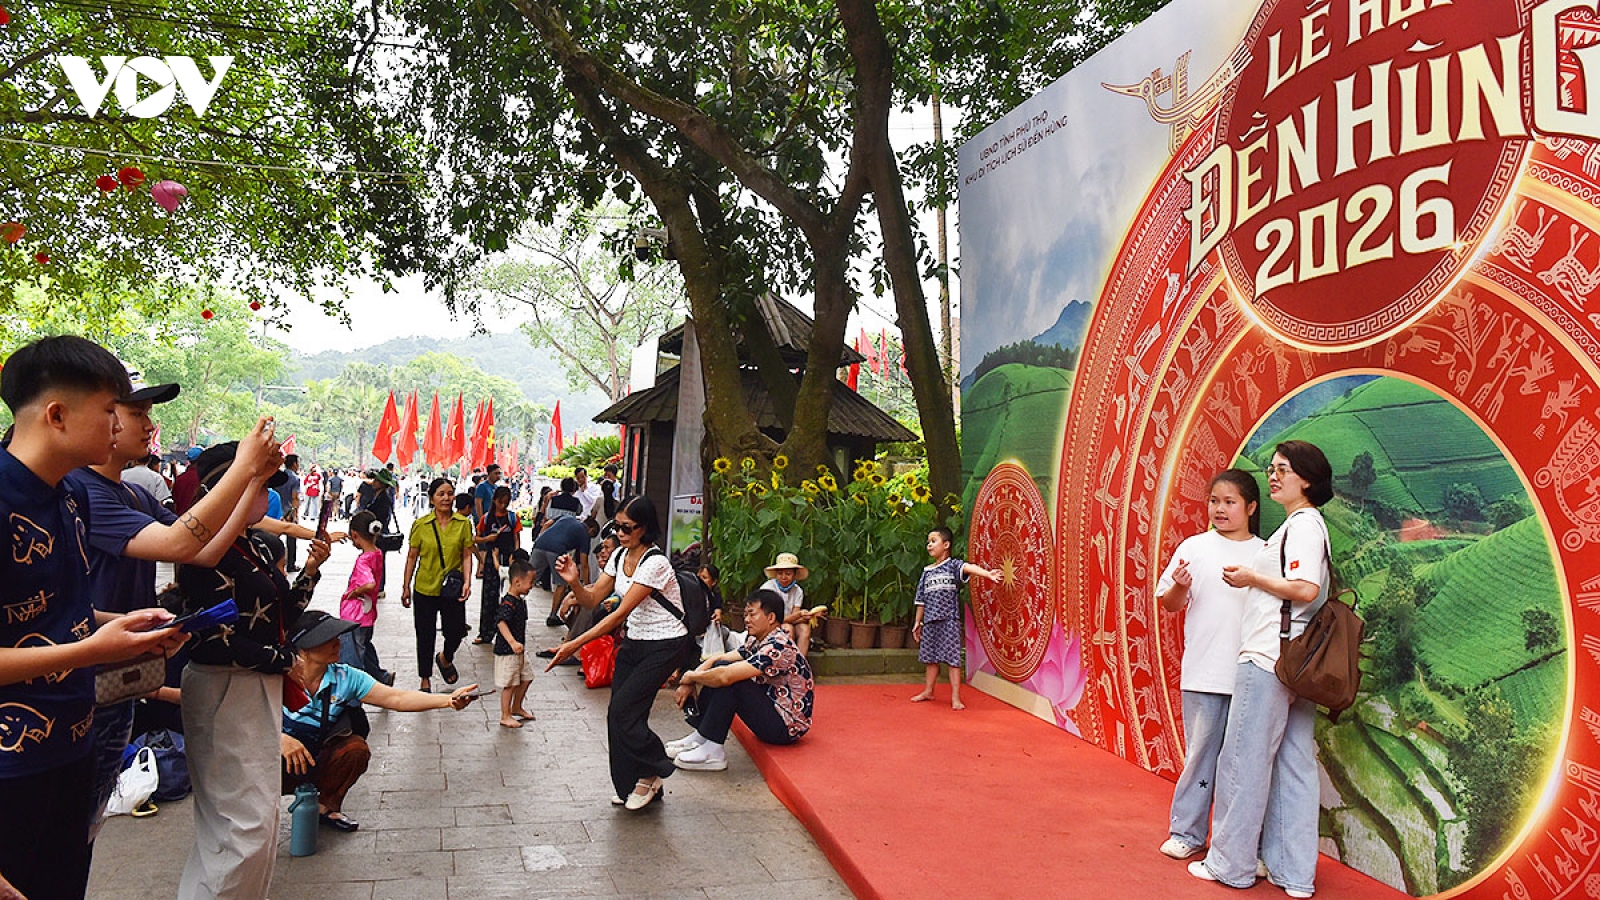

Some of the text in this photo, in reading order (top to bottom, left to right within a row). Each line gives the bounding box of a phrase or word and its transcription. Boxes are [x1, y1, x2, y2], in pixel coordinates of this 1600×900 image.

[965, 171, 978, 186] KHU
[978, 166, 986, 178] DI
[1045, 115, 1068, 137] HÙNG
[980, 142, 999, 161] UBND
[1183, 96, 1322, 278] ĐỀN
[1252, 158, 1455, 303] 2026
